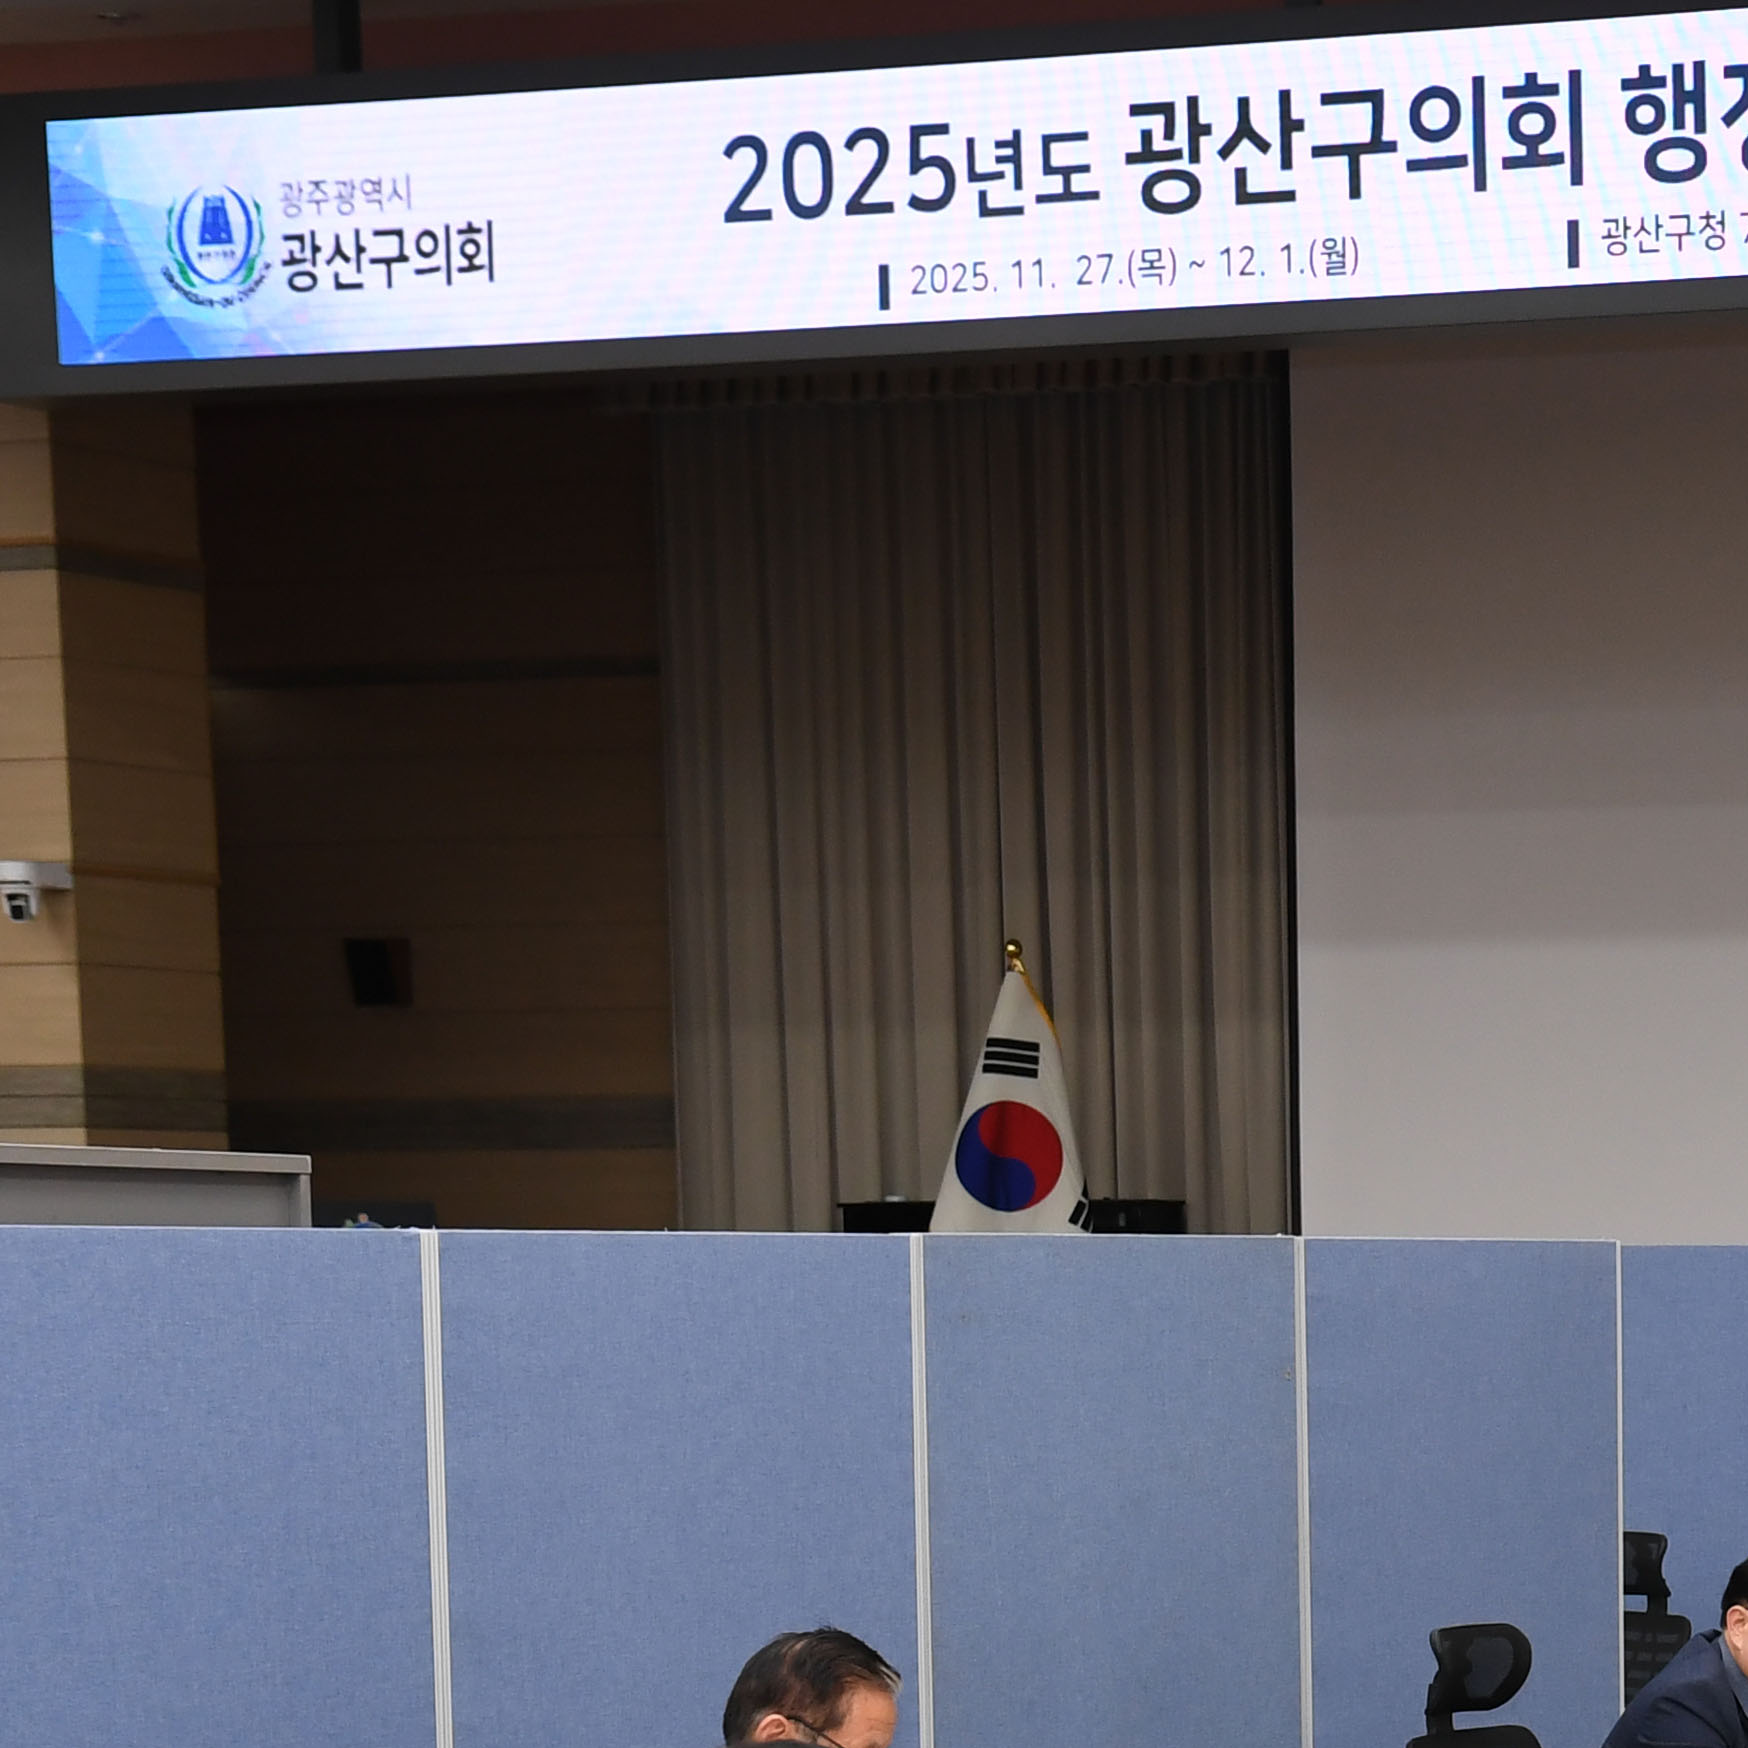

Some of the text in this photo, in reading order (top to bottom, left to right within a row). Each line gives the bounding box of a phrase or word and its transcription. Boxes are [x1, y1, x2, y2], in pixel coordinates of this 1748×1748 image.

[722, 122, 1100, 223] 2025년도
[1124, 68, 1583, 215] 광산구의회
[280, 173, 412, 218] 광주광역시
[281, 219, 495, 293] 광산구의회
[1600, 210, 1727, 256] 광산구청
[910, 263, 998, 296] 2025.
[1011, 257, 1056, 290] 11.
[1076, 246, 1177, 290] 27.(목)
[1219, 246, 1266, 279] 12.
[1280, 235, 1359, 280] 1.(월)
